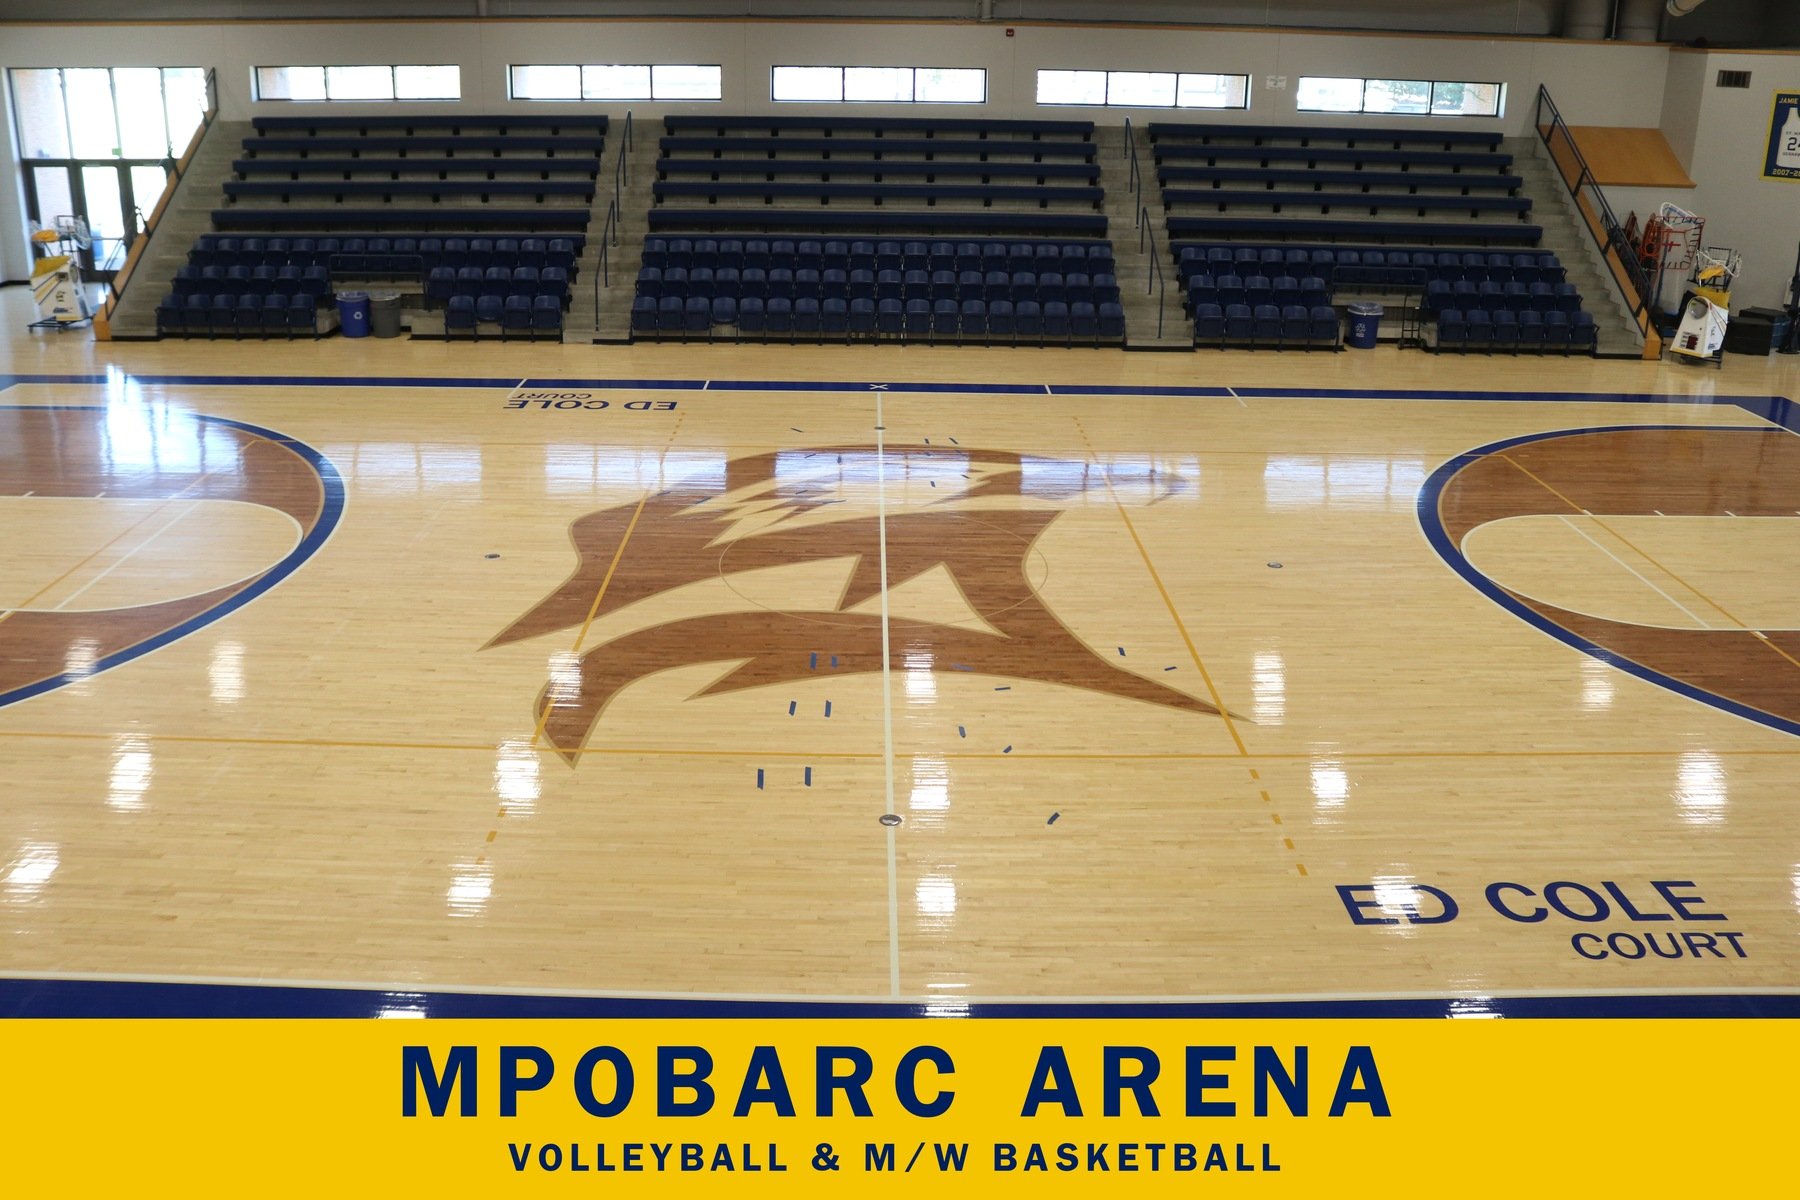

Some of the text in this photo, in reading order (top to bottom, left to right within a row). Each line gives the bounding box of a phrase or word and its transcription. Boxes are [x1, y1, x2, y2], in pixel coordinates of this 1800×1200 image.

[503, 400, 678, 411] ED COLE
[1335, 881, 1729, 925] ED COLE
[1571, 932, 1748, 960] COURT
